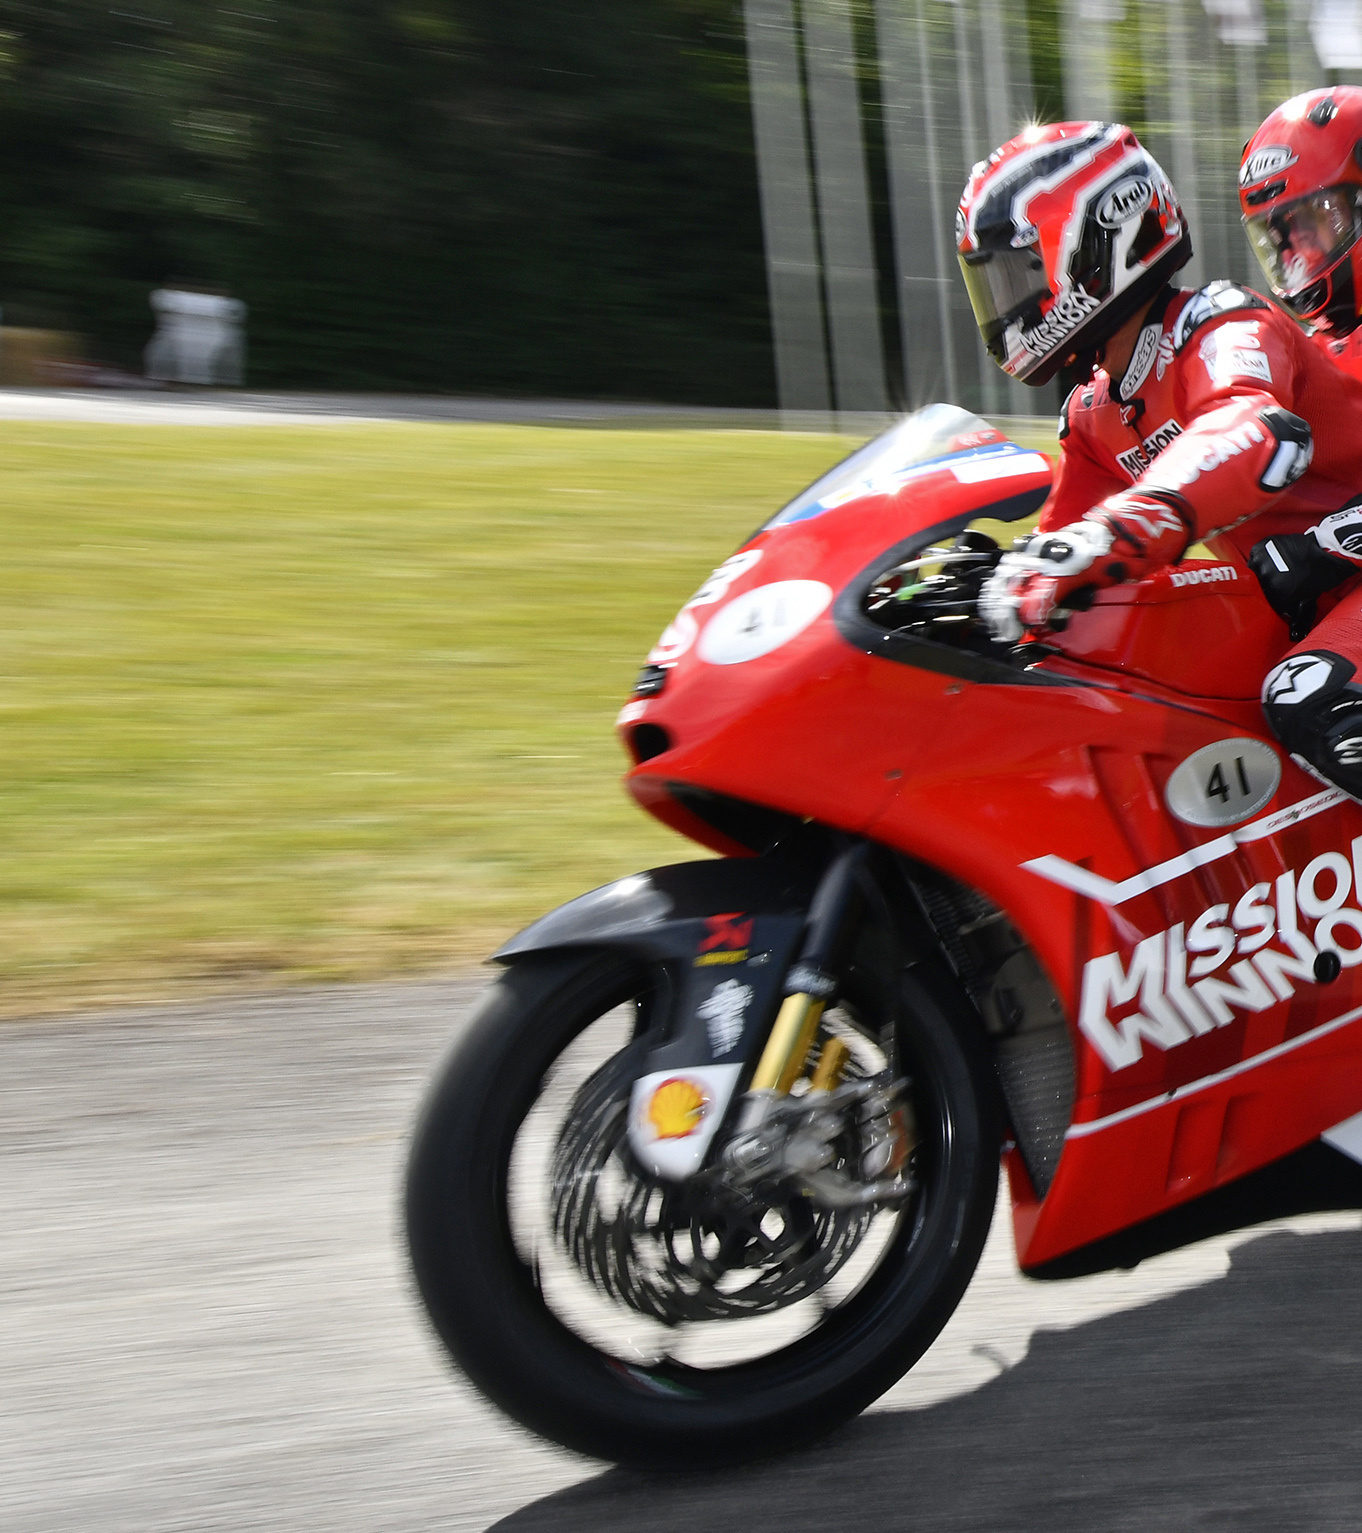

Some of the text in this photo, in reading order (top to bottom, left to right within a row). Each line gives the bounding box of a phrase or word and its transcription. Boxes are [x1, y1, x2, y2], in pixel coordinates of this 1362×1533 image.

[1100, 181, 1147, 222] Arai
[1120, 422, 1183, 480] MISSION
[1169, 566, 1239, 588] DUCATI
[1204, 756, 1252, 804] 41
